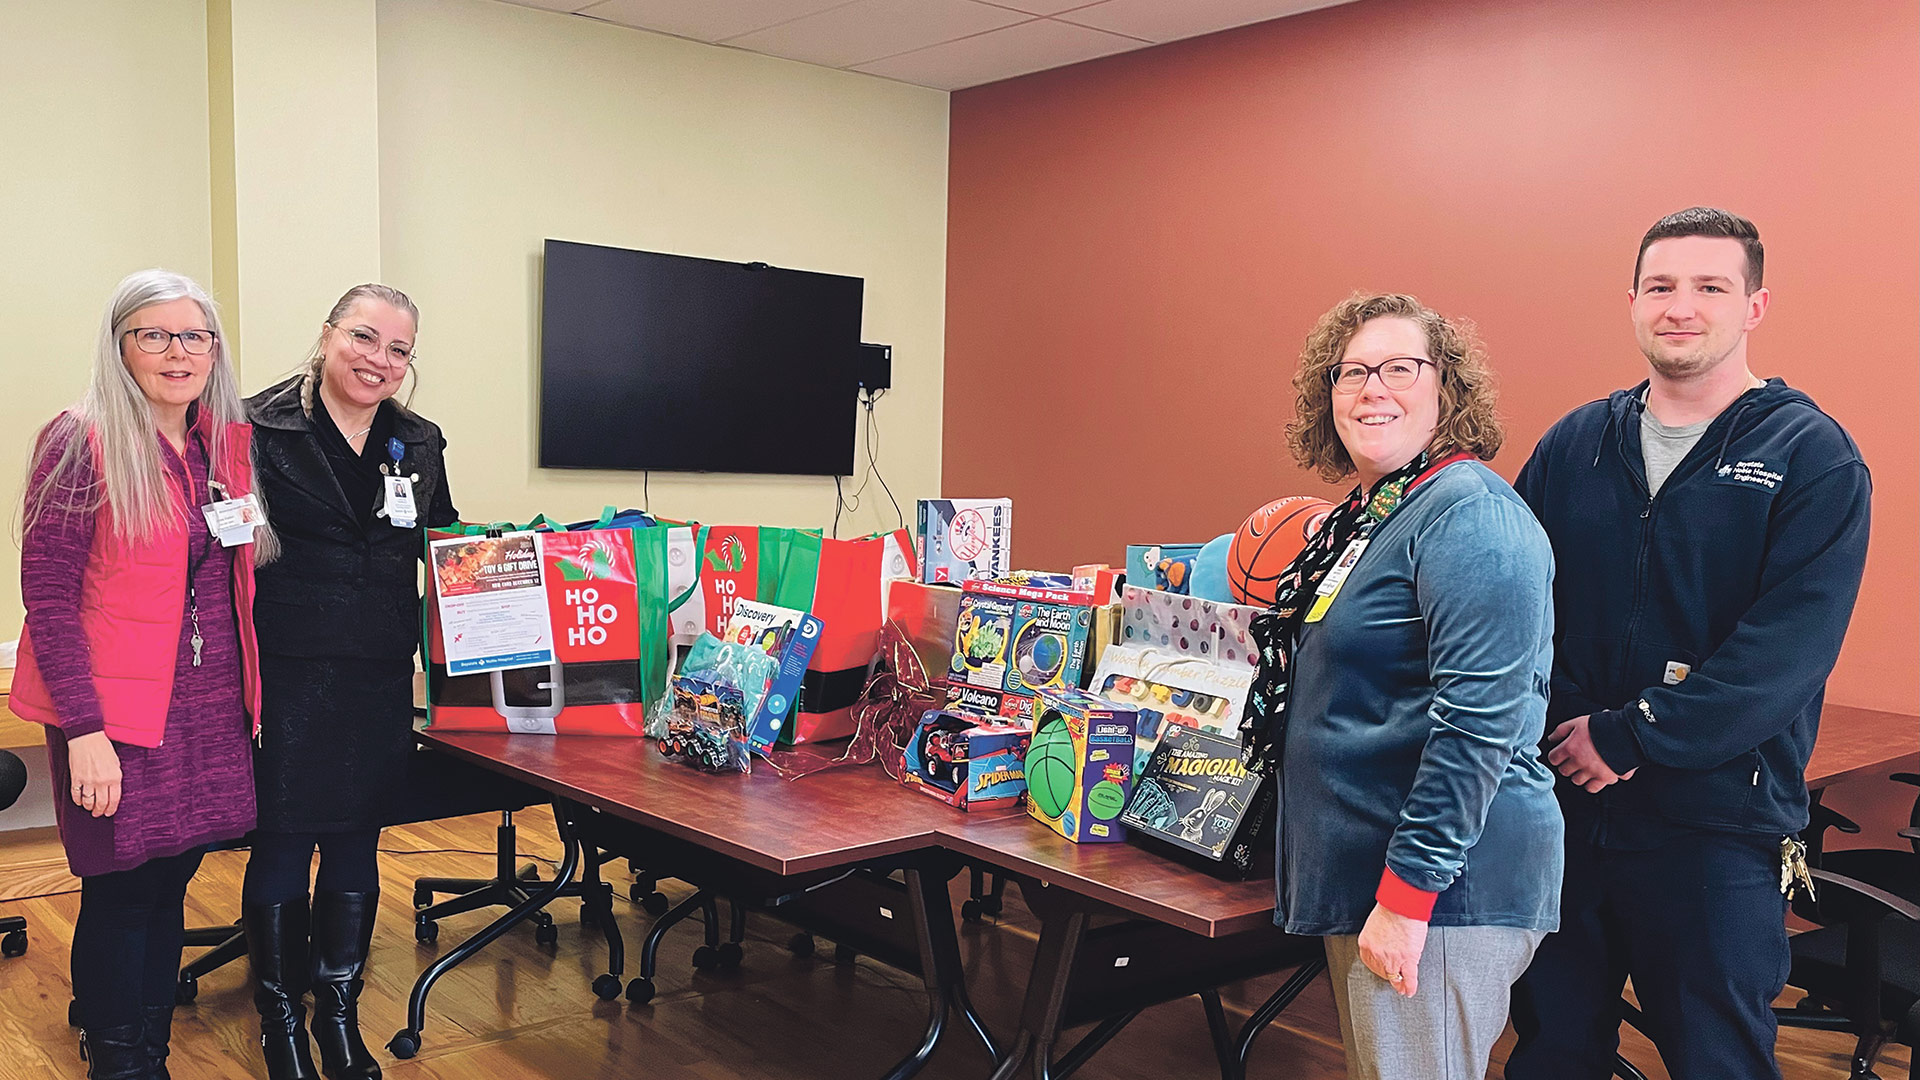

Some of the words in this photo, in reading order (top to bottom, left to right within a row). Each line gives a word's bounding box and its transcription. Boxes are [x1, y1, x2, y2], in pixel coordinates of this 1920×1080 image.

[1734, 474, 1775, 488] Engineering
[1753, 468, 1784, 481] Hospital
[990, 505, 1001, 579] YANKEES
[505, 549, 535, 560] Holiday
[483, 564, 496, 574] TOY
[503, 561, 517, 572] GIFT
[518, 559, 538, 570] DRIVE
[715, 579, 736, 595] HO
[982, 583, 1017, 594] Science
[1018, 588, 1043, 599] Mega
[1045, 591, 1069, 601] Pack
[565, 588, 599, 605] HO
[577, 604, 617, 625] HO
[973, 598, 992, 610] Crystal
[991, 601, 1014, 615] Growing
[1037, 606, 1050, 618] The
[1050, 608, 1070, 620] Earth
[736, 604, 776, 626] Discovery
[717, 616, 727, 633] H
[1035, 618, 1048, 627] and
[1049, 619, 1071, 630] Moon
[568, 626, 607, 646] HO
[1205, 670, 1248, 689] Puzzle
[962, 688, 997, 707] Volcano
[1019, 699, 1033, 715] Dig
[1090, 735, 1132, 743] BASKETBALL
[1171, 749, 1181, 757] THE
[1180, 750, 1208, 759] AMAZING
[1165, 757, 1247, 778] MAGICIAN
[1212, 775, 1231, 784] MAGIC
[1230, 777, 1243, 786] KIT
